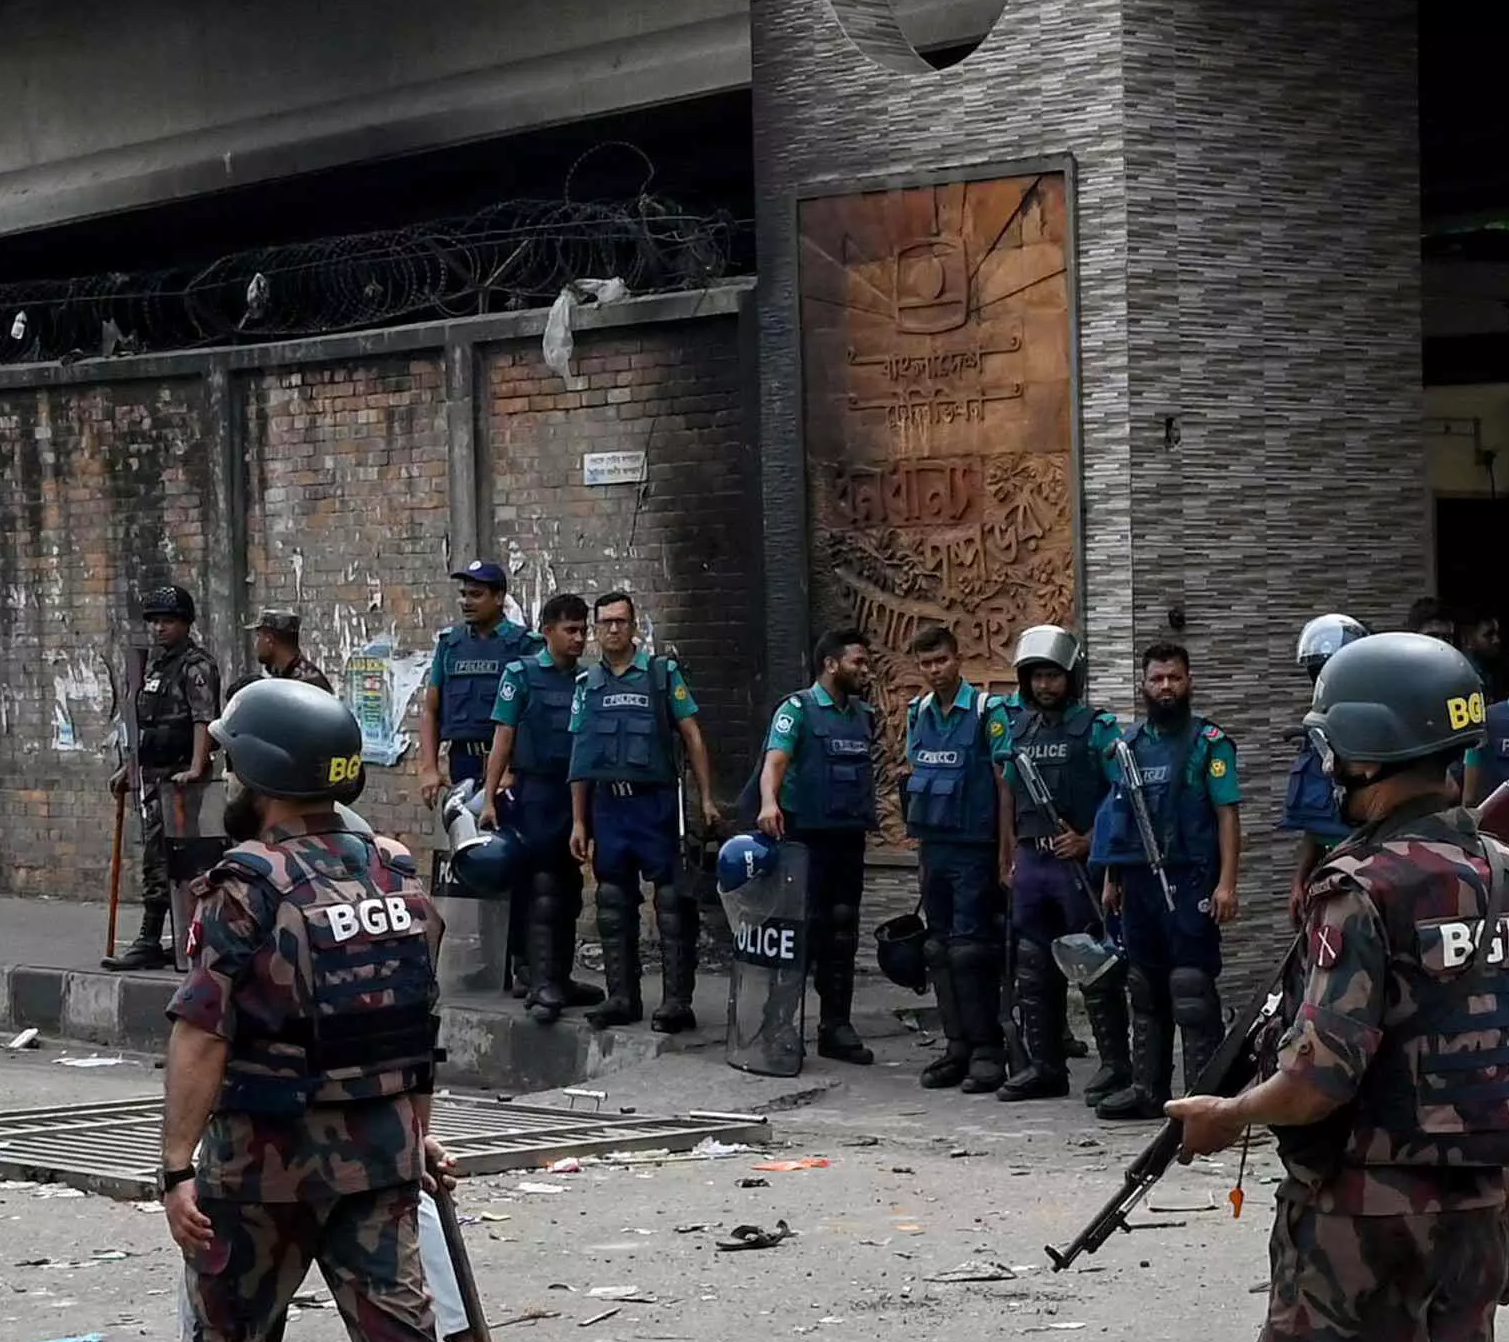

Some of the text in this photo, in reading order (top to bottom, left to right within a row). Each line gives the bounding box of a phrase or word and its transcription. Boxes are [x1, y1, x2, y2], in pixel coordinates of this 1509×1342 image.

[1446, 692, 1486, 730] BG
[325, 896, 412, 943] BGB
[735, 921, 795, 959] OLICE
